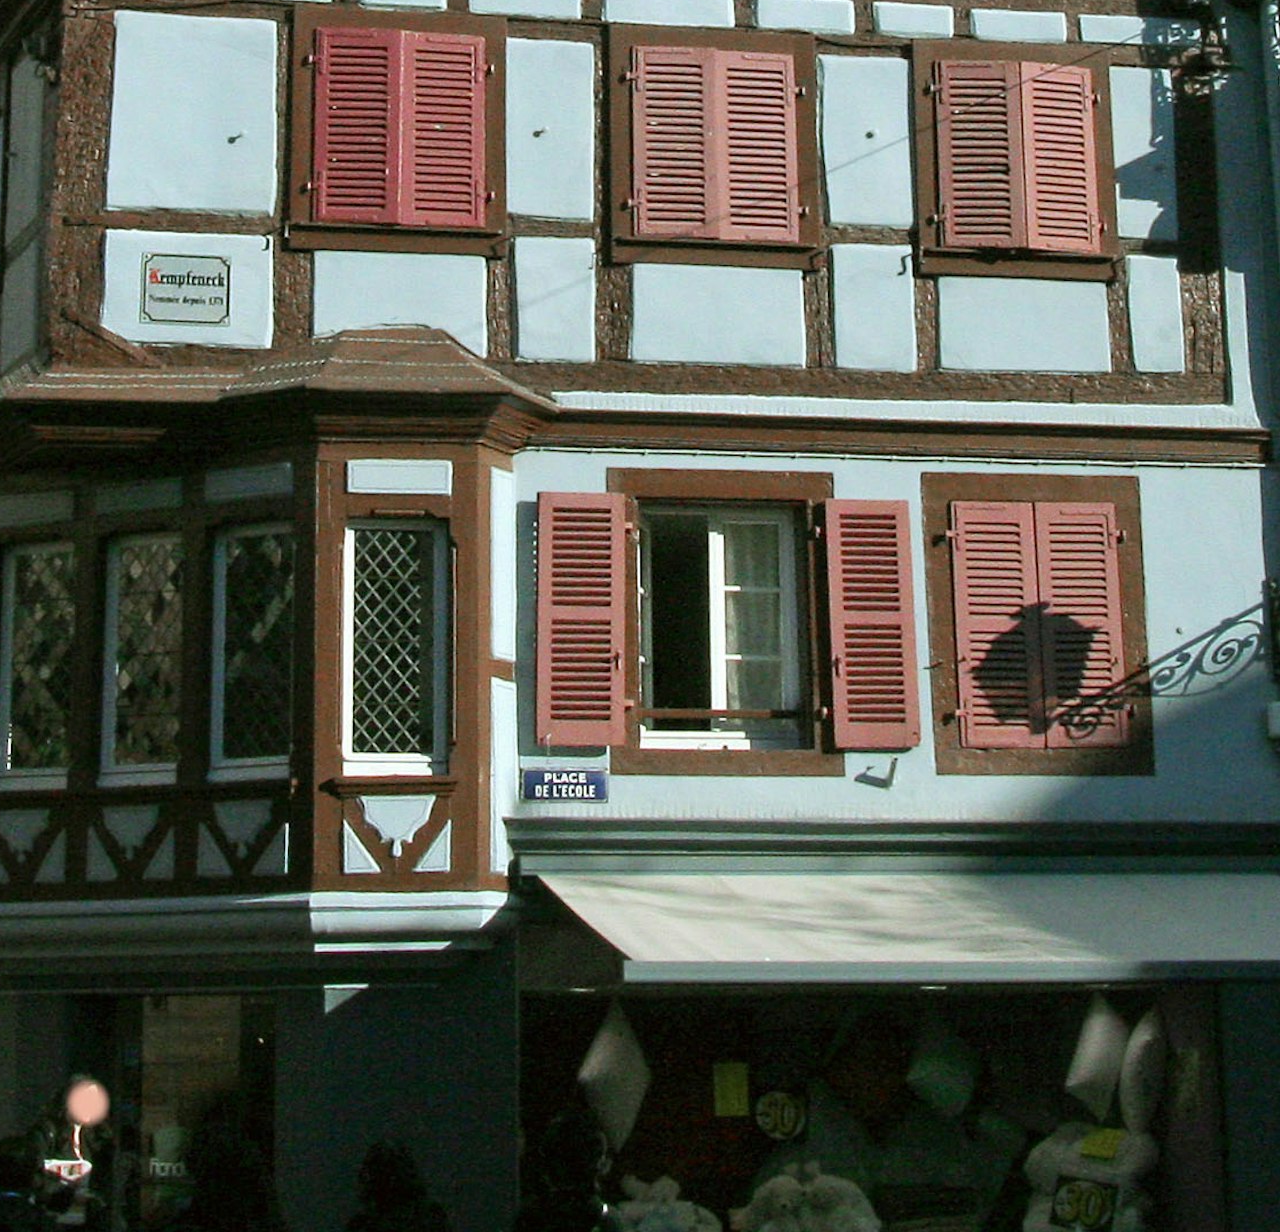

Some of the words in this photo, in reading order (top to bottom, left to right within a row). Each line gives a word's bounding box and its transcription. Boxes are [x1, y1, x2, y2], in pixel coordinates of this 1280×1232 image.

[544, 772, 587, 783] PLACE
[535, 785, 549, 797] DE
[553, 784, 596, 797] L'ECOLE
